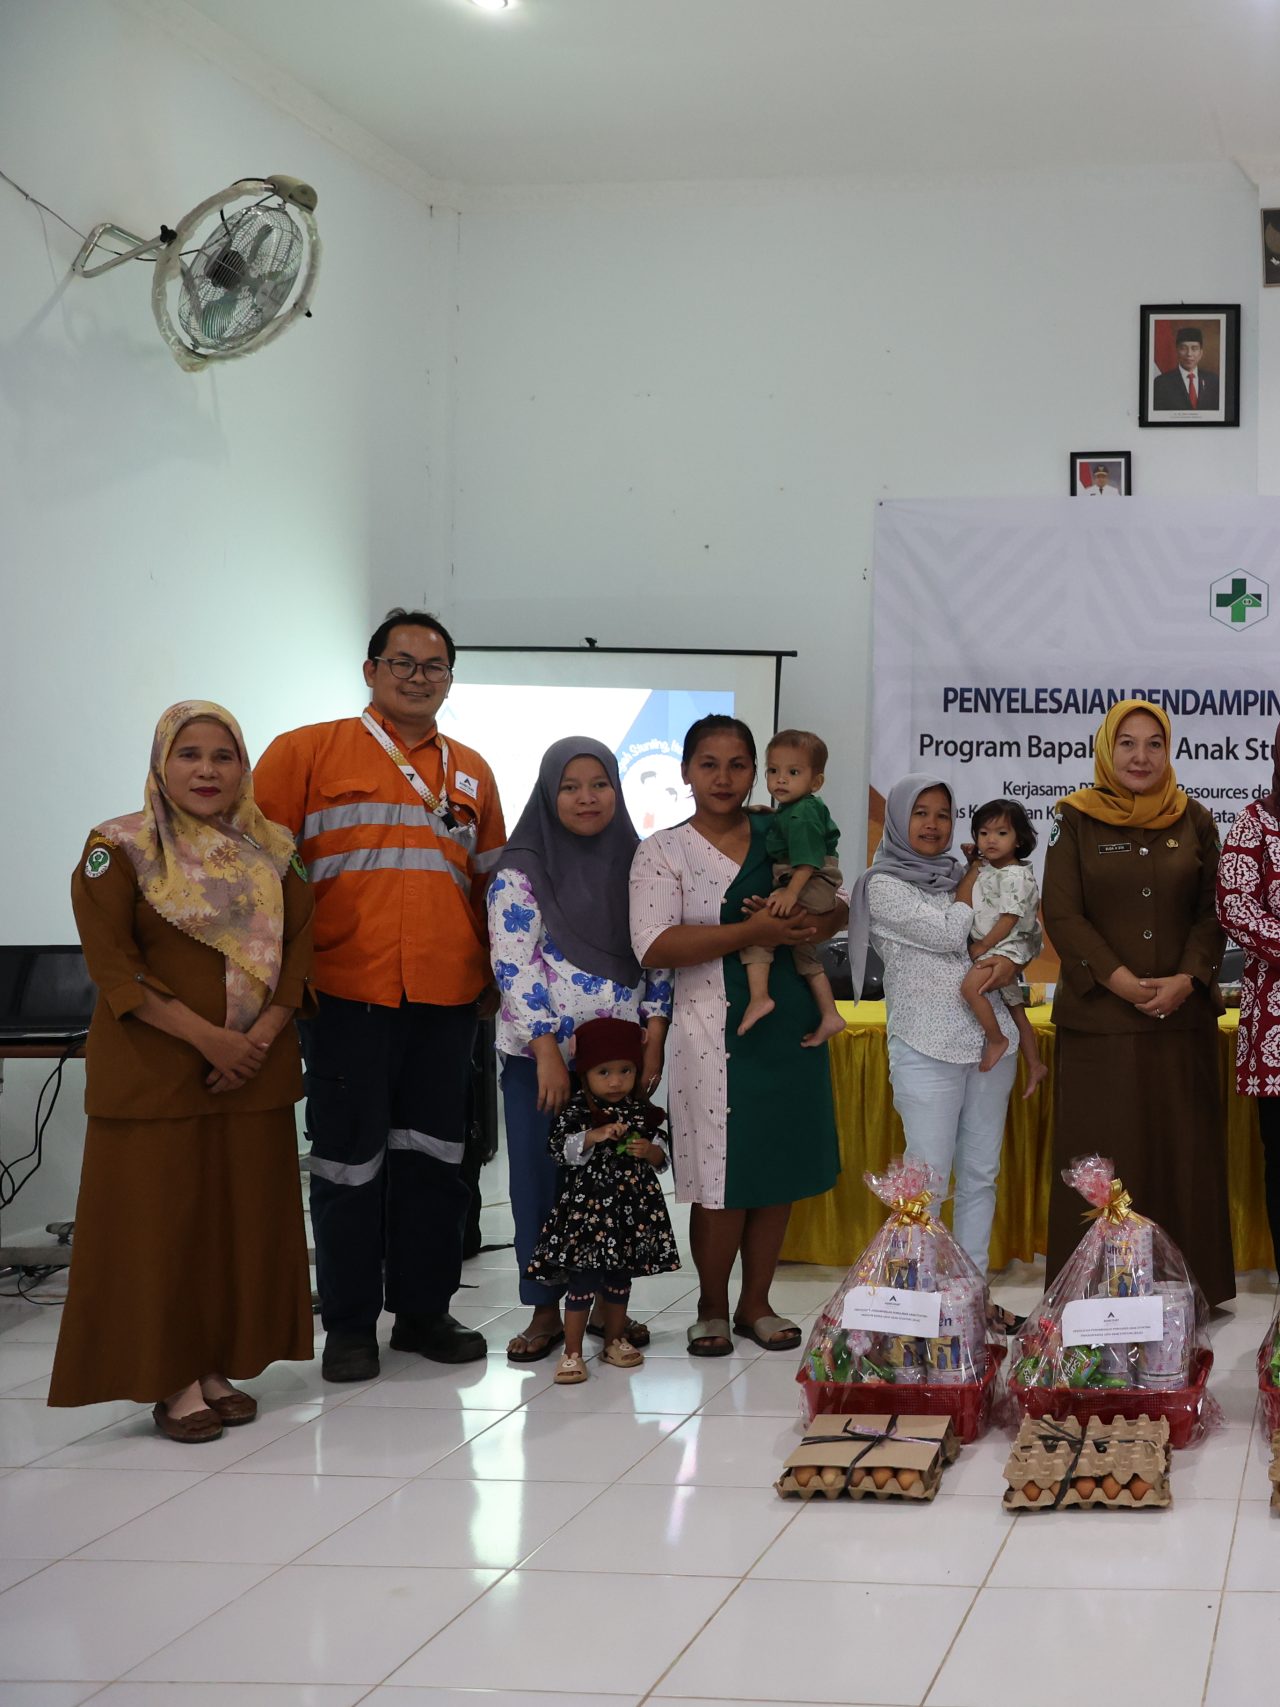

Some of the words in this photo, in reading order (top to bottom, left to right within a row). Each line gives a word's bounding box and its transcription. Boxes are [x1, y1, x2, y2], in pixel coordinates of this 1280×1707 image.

[919, 733, 1021, 763] Program
[1175, 736, 1240, 761] Anak
[1003, 781, 1076, 799] Kerjasama
